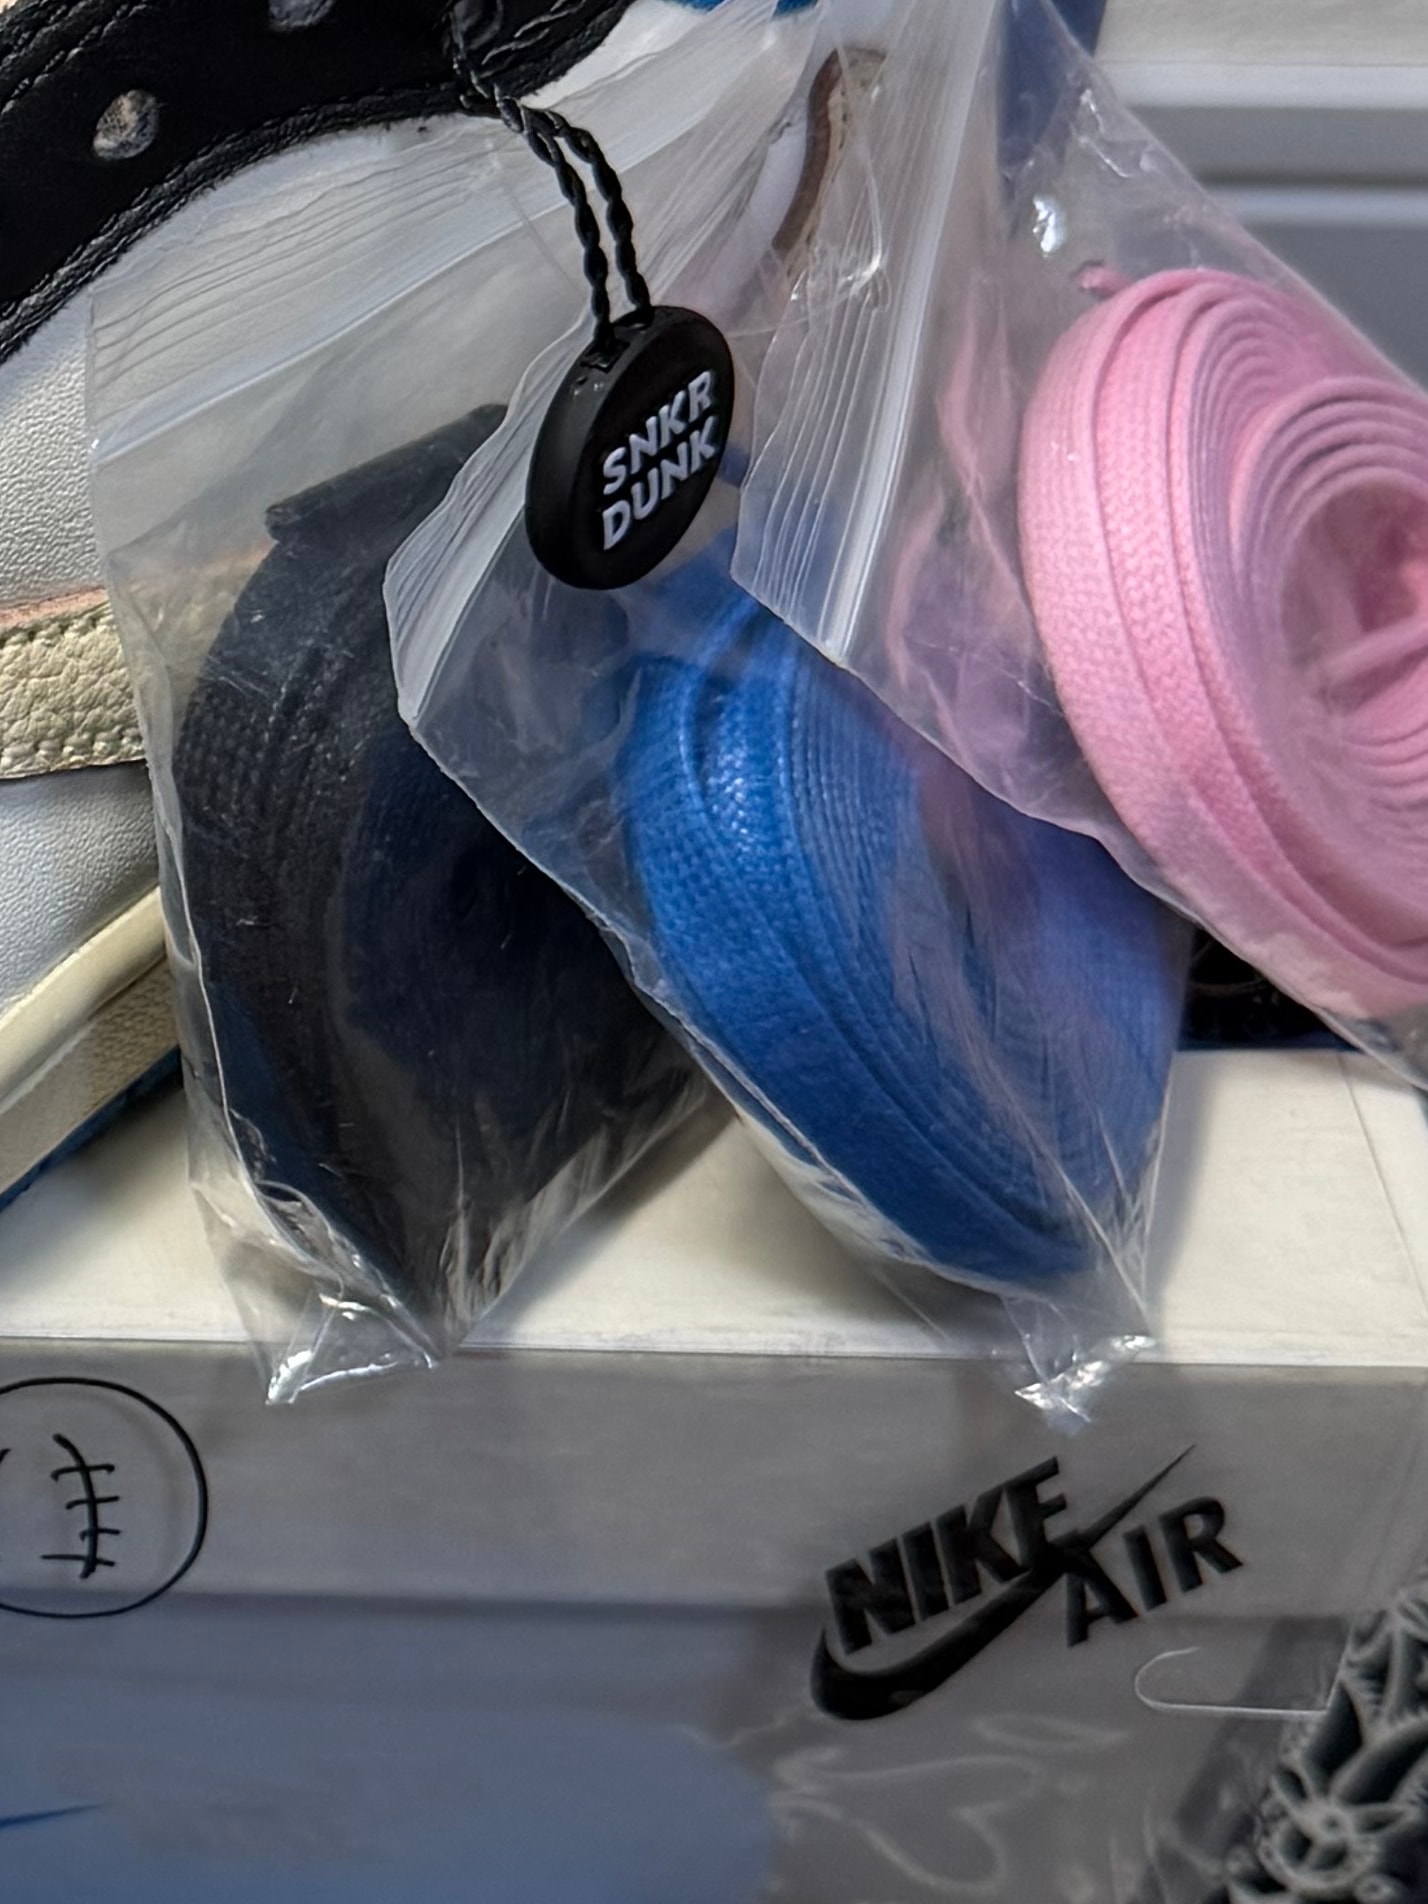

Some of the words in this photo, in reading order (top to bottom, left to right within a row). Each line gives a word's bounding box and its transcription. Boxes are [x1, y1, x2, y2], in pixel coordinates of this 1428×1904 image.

[602, 370, 715, 495] SNKR
[602, 416, 716, 550] DUNK
[825, 1456, 1068, 1654] NIKE
[1066, 1497, 1244, 1647] AIR
